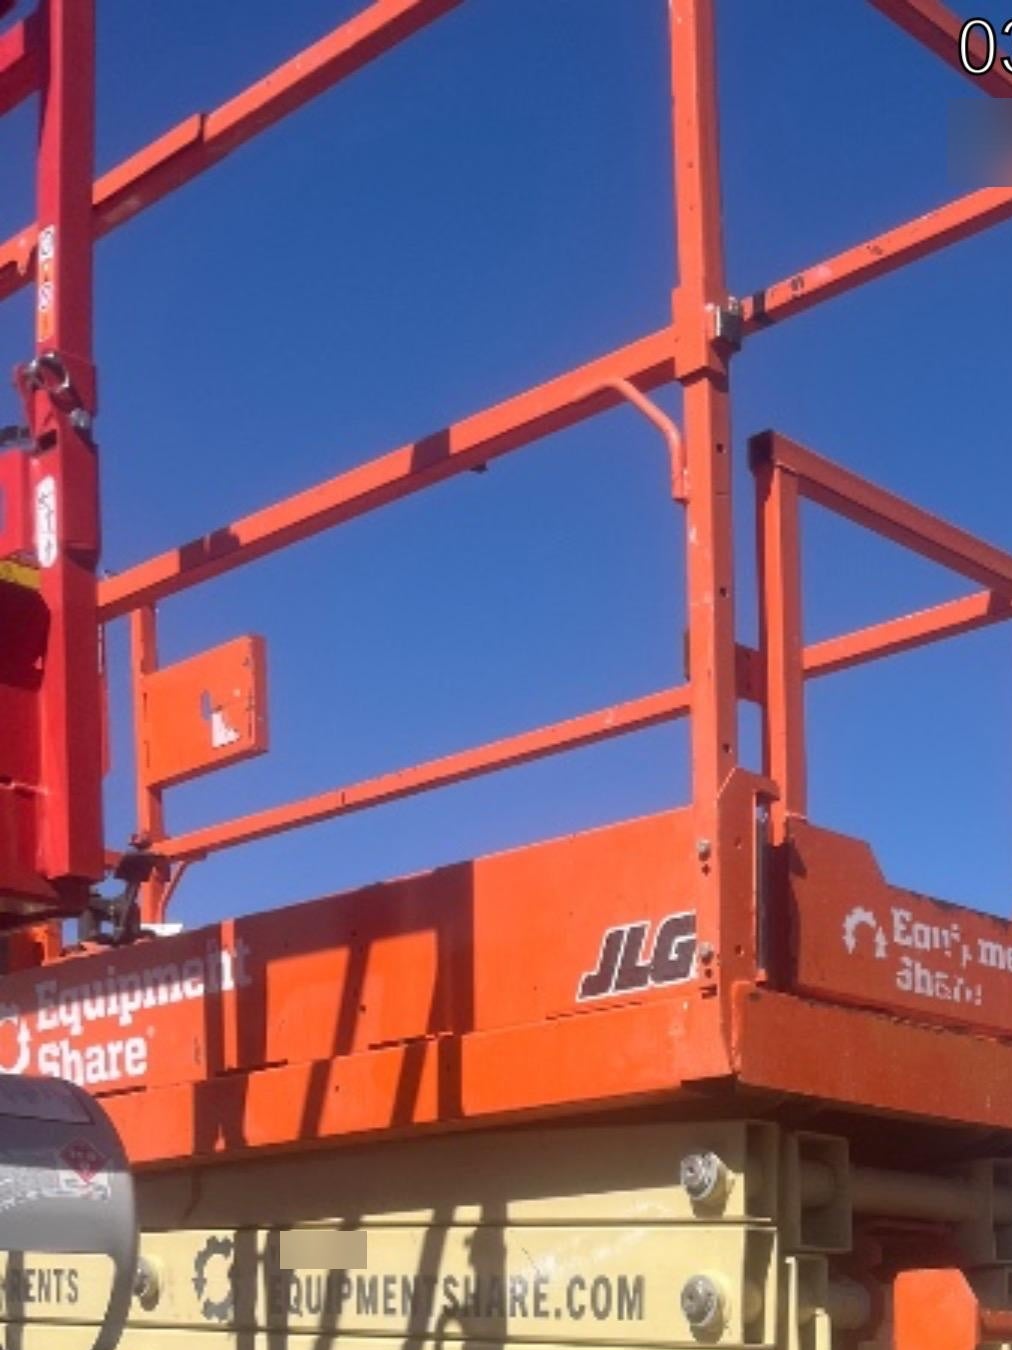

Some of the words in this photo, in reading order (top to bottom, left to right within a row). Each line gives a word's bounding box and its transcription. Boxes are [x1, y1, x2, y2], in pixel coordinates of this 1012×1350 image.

[36, 937, 252, 1036] Equipment
[576, 908, 697, 1003] JLG
[37, 1037, 148, 1087] Share
[268, 1272, 646, 1321] EQUIPMENTSHARE.COM
